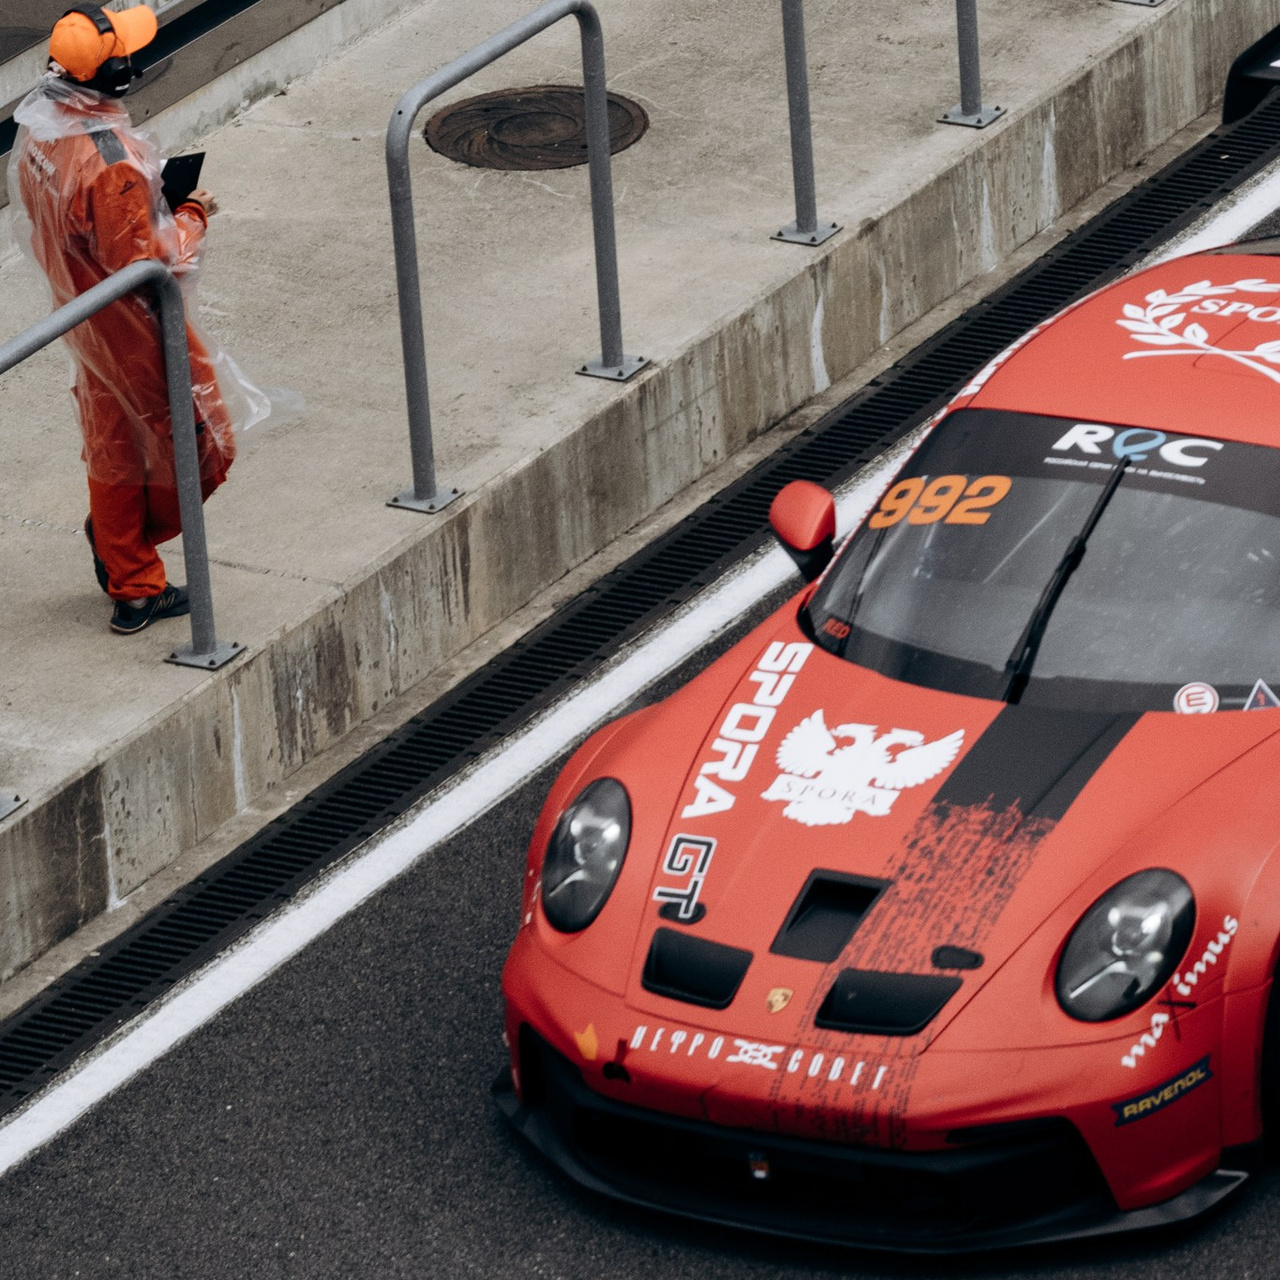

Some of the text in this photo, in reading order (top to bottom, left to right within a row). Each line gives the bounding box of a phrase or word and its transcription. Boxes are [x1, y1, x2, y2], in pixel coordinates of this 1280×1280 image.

[868, 474, 1012, 530] 992
[652, 641, 815, 919] SPORA GT
[782, 780, 877, 807] SPORA
[1123, 1068, 1206, 1118] RAVENOL
